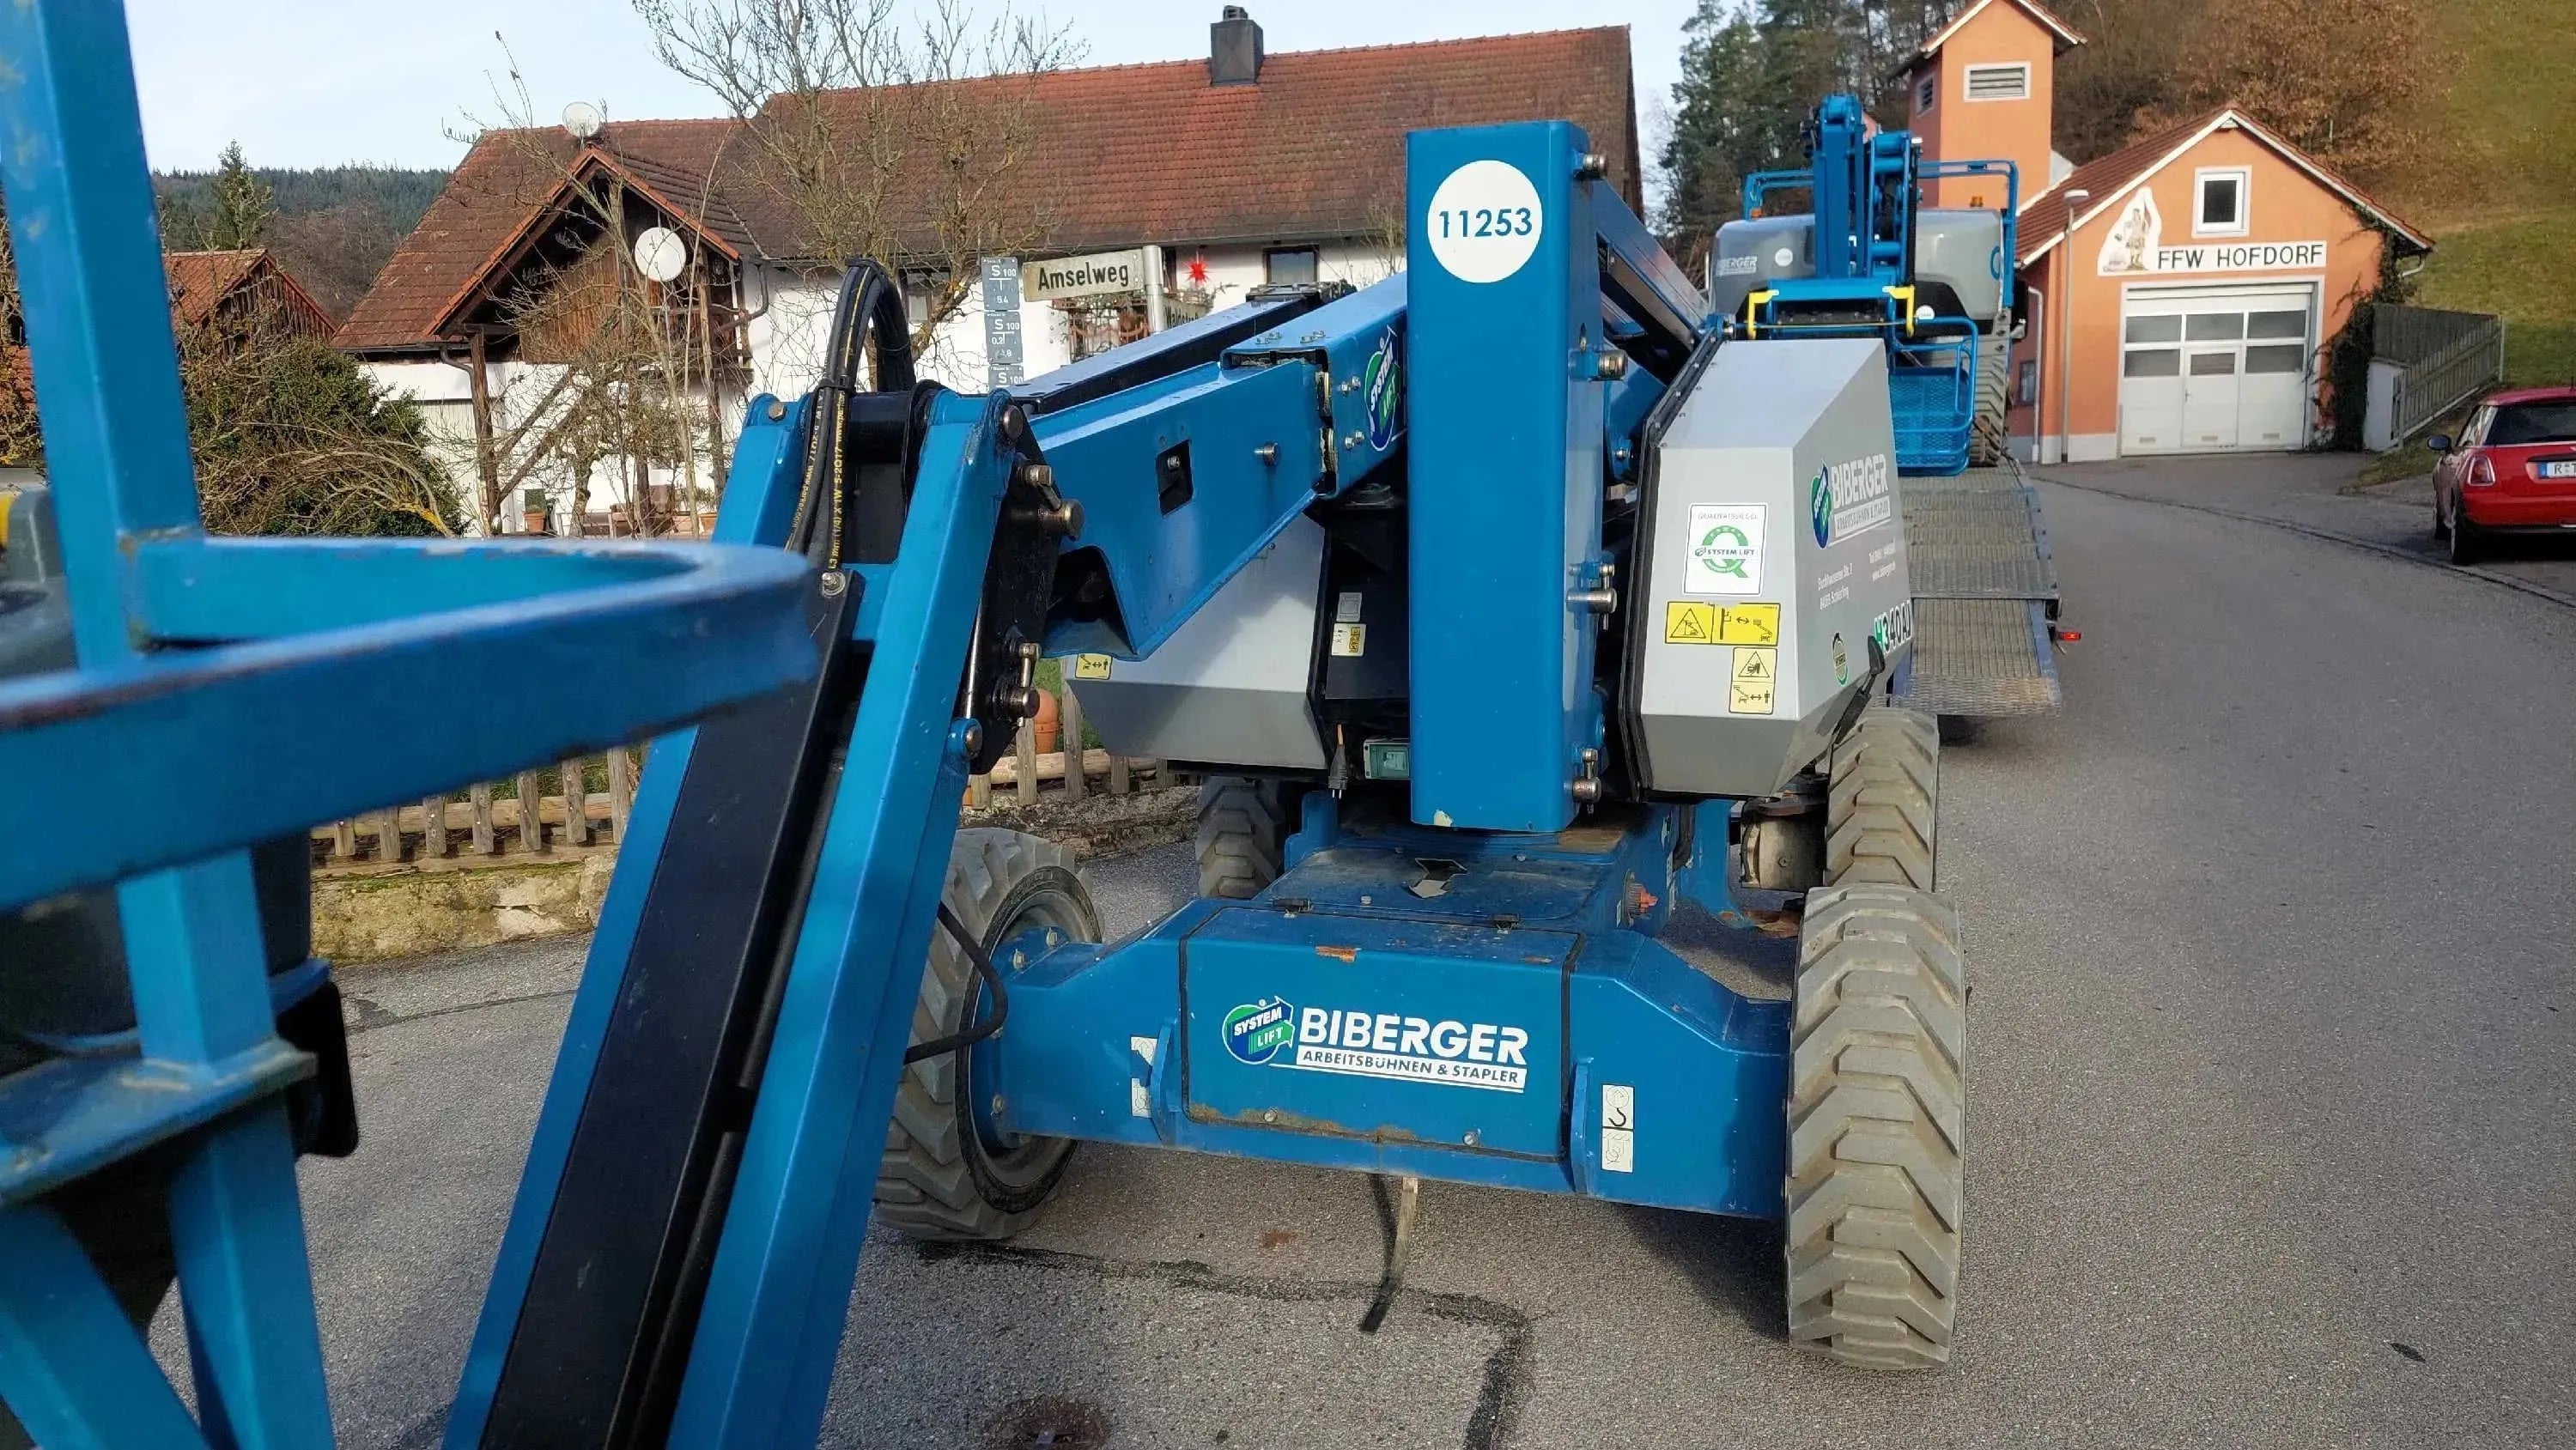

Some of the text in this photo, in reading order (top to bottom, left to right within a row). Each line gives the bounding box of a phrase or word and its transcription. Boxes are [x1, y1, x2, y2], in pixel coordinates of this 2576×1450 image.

[1438, 207, 1533, 239] 11253
[991, 264, 1017, 277] S 100
[2157, 244, 2324, 270] FFW HOFDORF
[1037, 261, 1129, 291] Amselweg
[994, 319, 1020, 331] S 100
[998, 372, 1007, 384] S
[1831, 453, 1889, 509] BIBERGER
[2554, 464, 2562, 474] R
[1234, 1006, 1284, 1047] SYSTEM LIFT
[1299, 1007, 1528, 1065] BIBERGER
[1303, 1050, 1518, 1083] ARBEITSBÜHNEN & STAPLER
